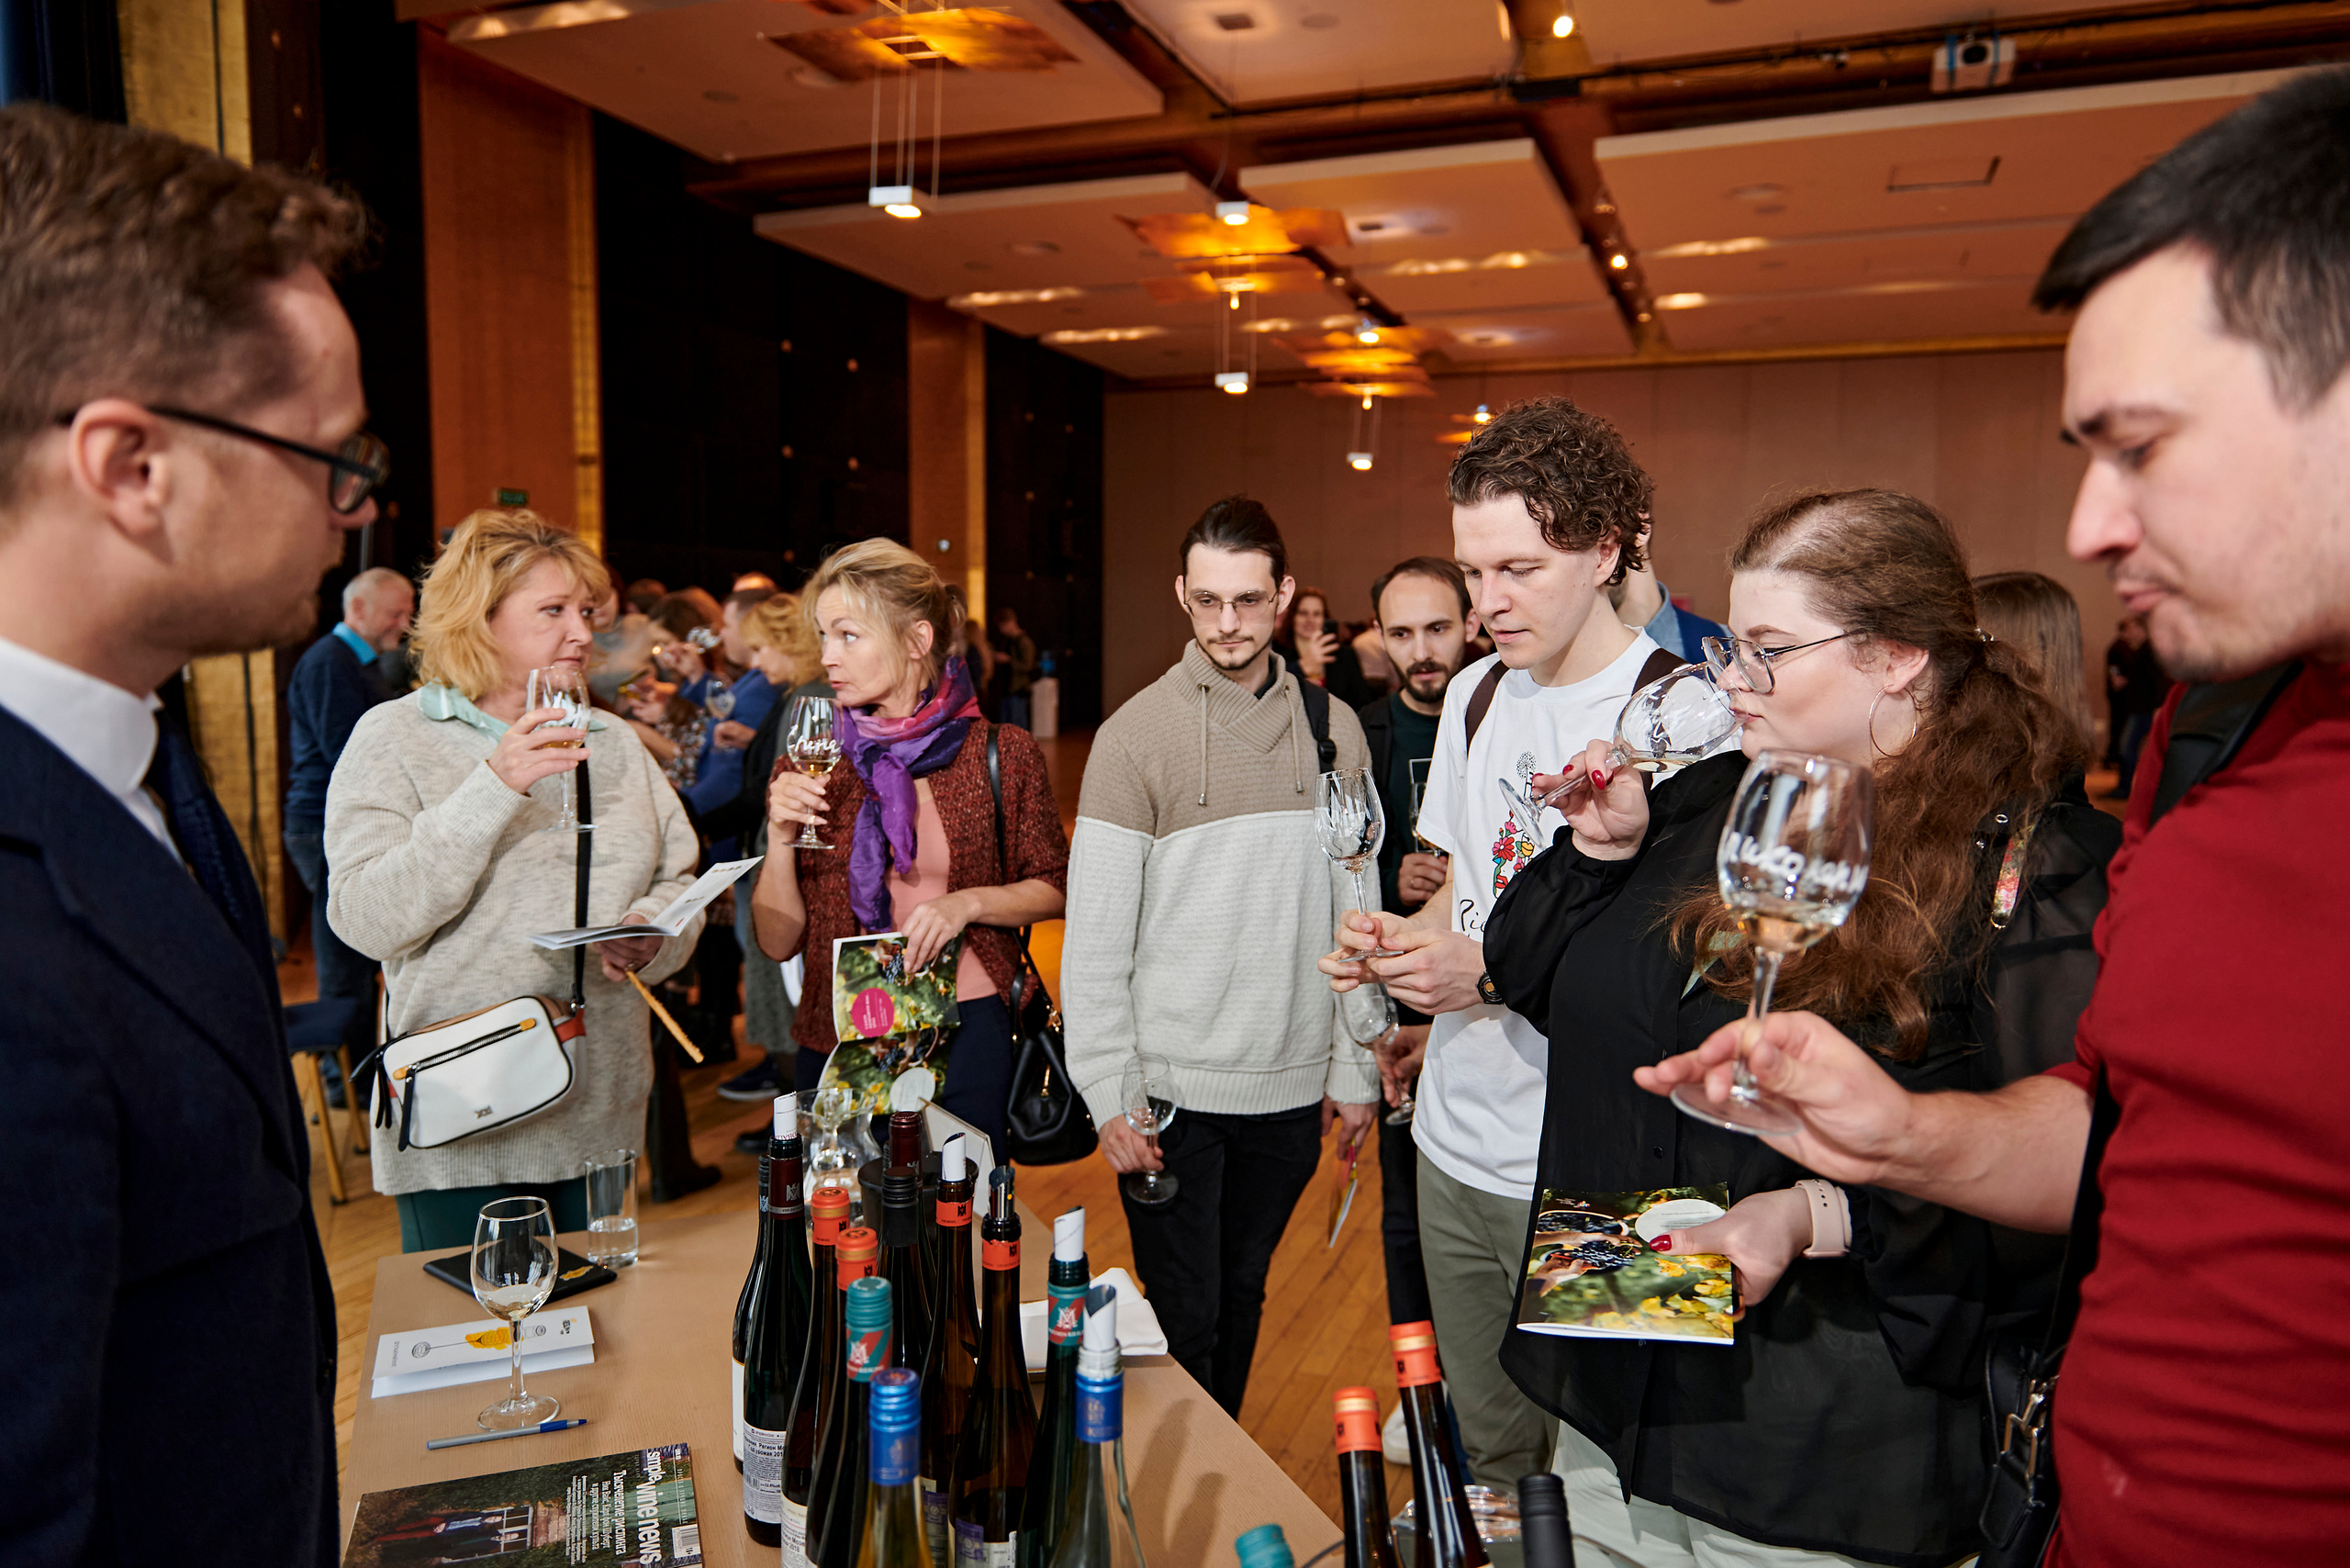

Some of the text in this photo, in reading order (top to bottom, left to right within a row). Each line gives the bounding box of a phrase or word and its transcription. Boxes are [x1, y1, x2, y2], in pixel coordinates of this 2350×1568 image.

[611, 1470, 627, 1555] Тысячелетие рислинга
[635, 1481, 663, 1518] wine
[637, 1518, 663, 1565] news
